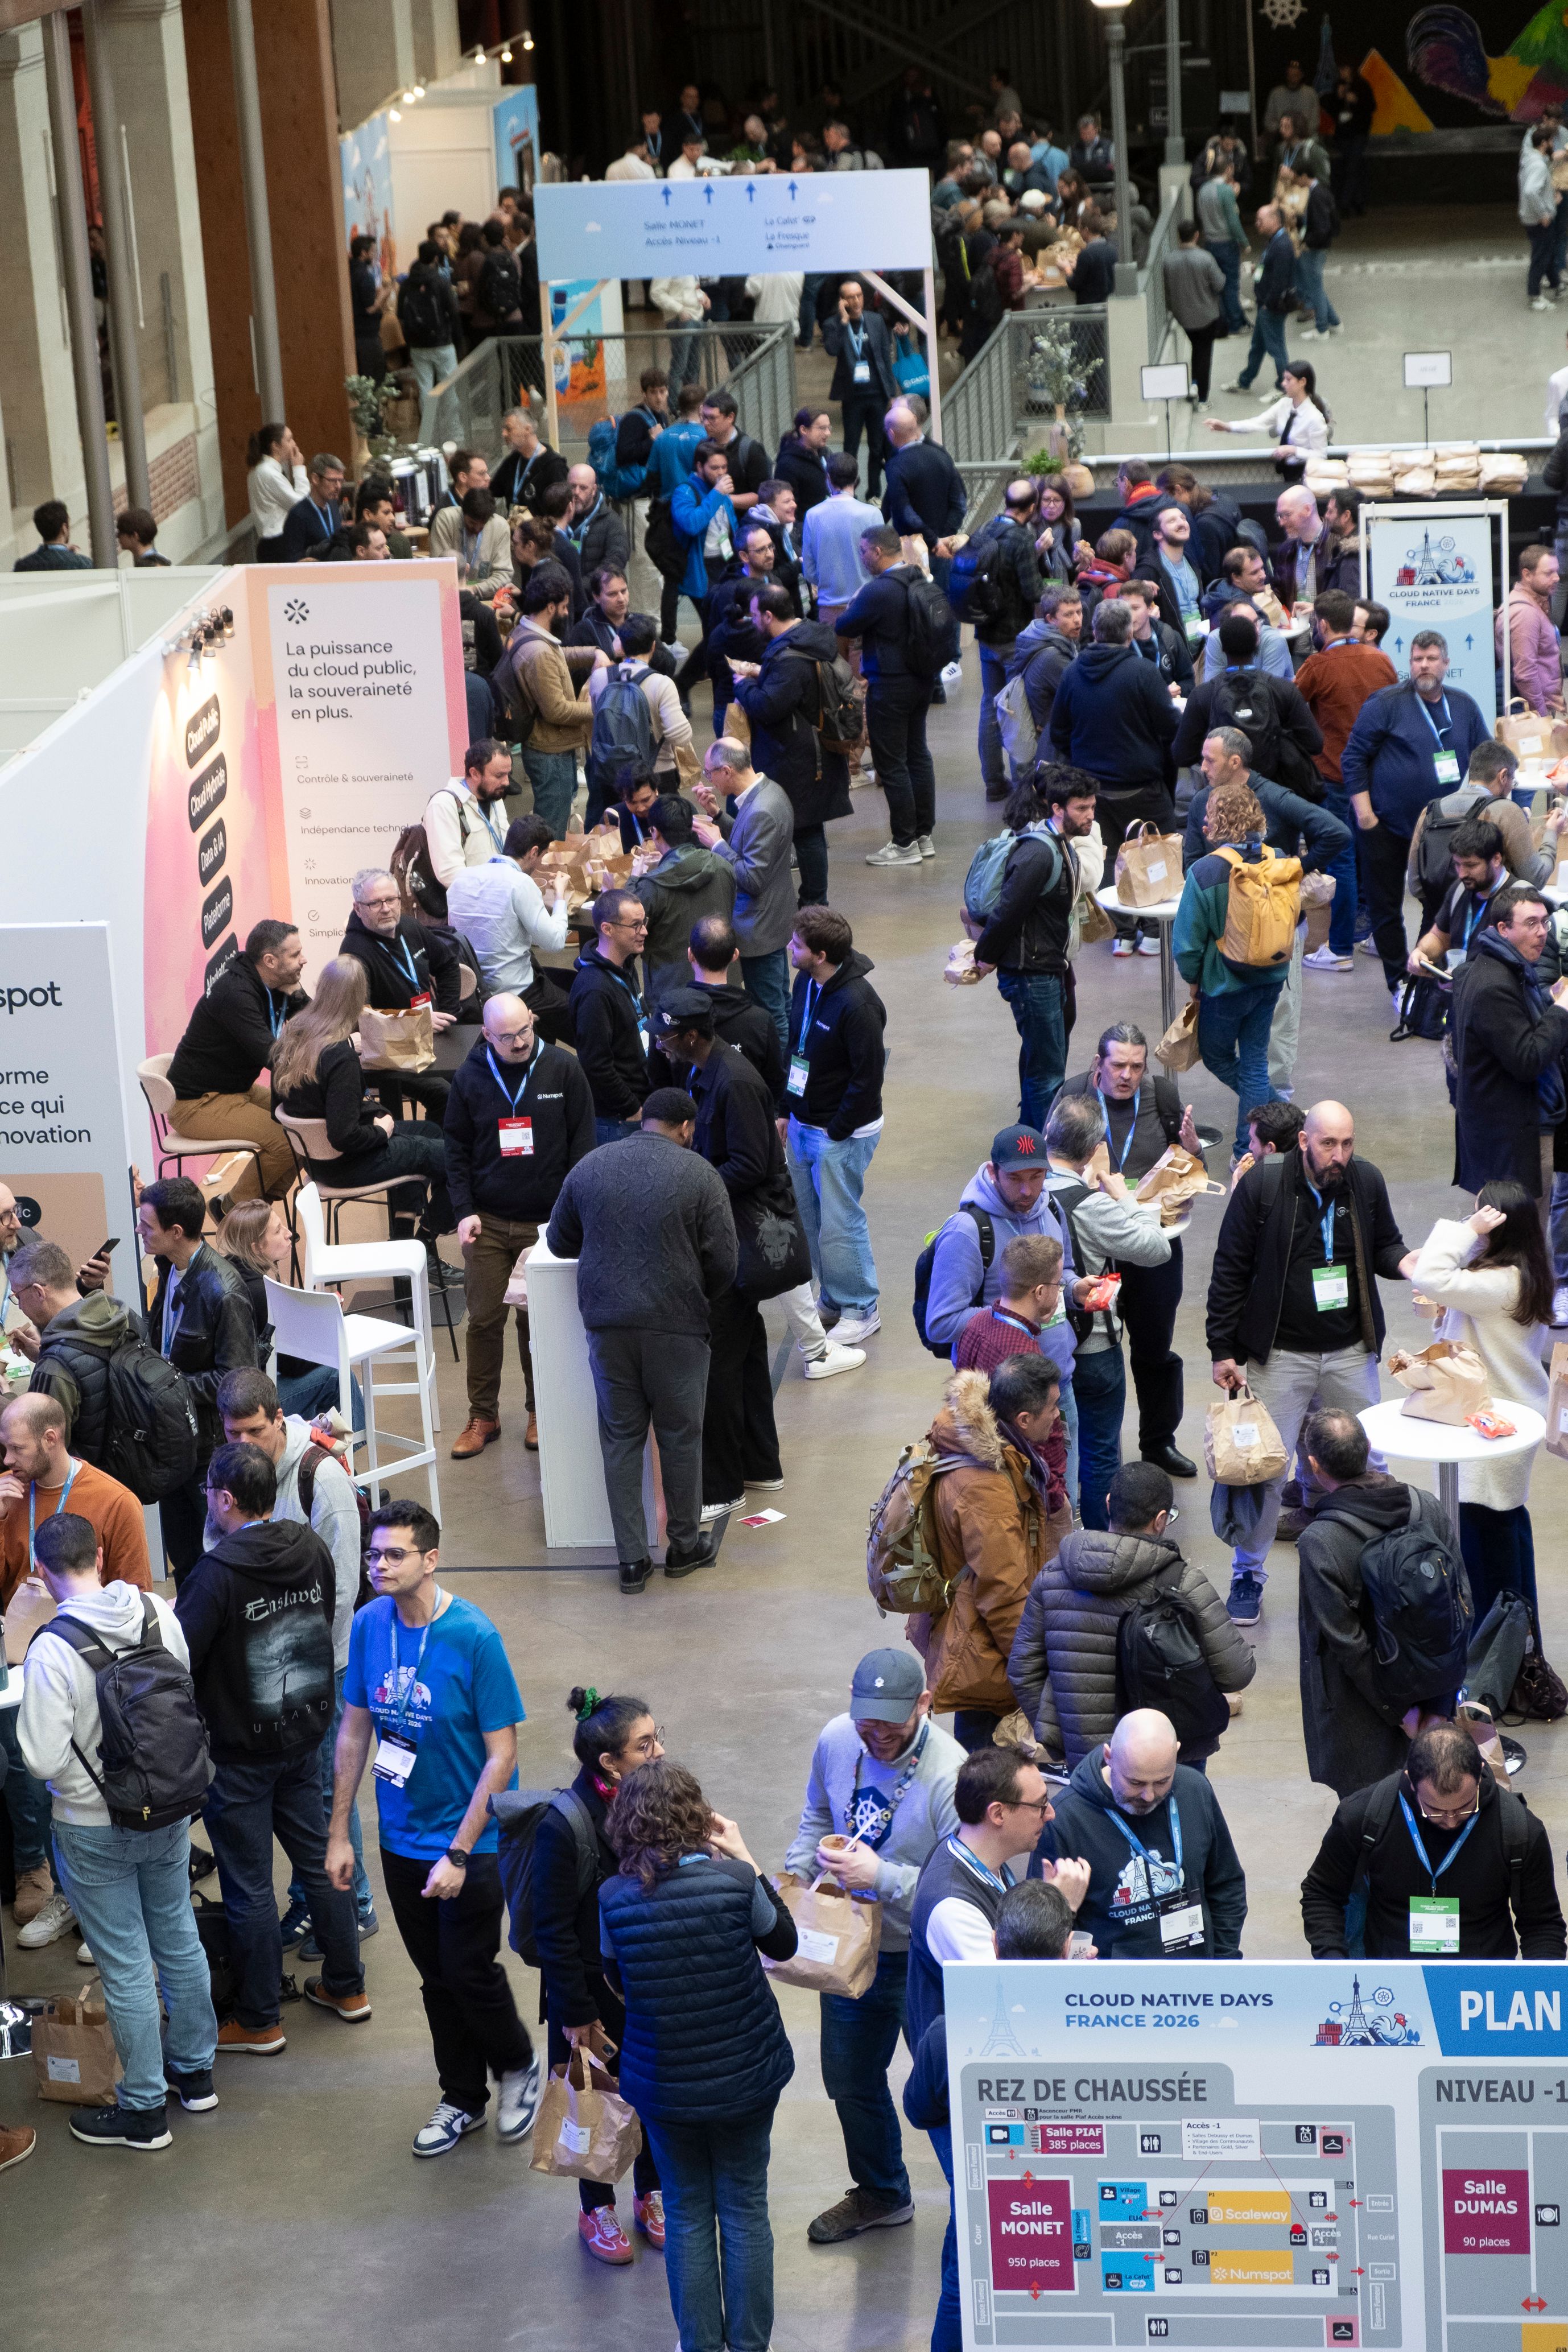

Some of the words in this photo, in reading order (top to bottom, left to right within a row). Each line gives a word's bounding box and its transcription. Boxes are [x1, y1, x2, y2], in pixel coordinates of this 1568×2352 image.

[644, 221, 666, 230] Salle
[670, 220, 704, 228] MONET
[645, 236, 672, 245] Accès
[676, 236, 707, 245] Niveau
[766, 232, 775, 241] La
[778, 232, 809, 242] Fresque
[286, 642, 305, 655] La
[310, 641, 393, 659] puissance
[288, 663, 308, 676] du
[313, 662, 358, 676] cloud
[363, 660, 416, 678] public,
[290, 685, 303, 698] la
[308, 681, 412, 698] souveraineté
[291, 708, 311, 719] en
[316, 705, 353, 722] plus.
[188, 721, 203, 753] Cloud
[203, 708, 218, 739] Public
[297, 774, 339, 783] Contrôle
[342, 774, 349, 782] &
[352, 772, 414, 782] souveraineté
[191, 785, 207, 817] Cloud
[205, 767, 225, 802] Hybride
[301, 825, 370, 836] Indépendance
[200, 845, 213, 872] Data
[213, 837, 218, 852] &
[218, 831, 225, 852] IA
[204, 893, 230, 934] Plateforme
[31, 1095, 64, 1119] qui
[240, 1579, 324, 1621] Enslaved
[254, 1701, 328, 1733] UTGARD
[1109, 1908, 1137, 1918] CLOUD
[1065, 1994, 1135, 2007] CLOUD
[1141, 1994, 1214, 2007] NATIVE
[1220, 1994, 1274, 2007] DAYS
[1460, 1991, 1561, 2031] PLAN
[1066, 2015, 1146, 2027] FRANCE
[1153, 2015, 1200, 2027] 2026
[978, 2079, 1025, 2102] REZ
[1034, 2079, 1067, 2102] DE
[1075, 2071, 1207, 2102] CHAUSSÉE
[1436, 2079, 1534, 2103] NIVEAU
[1544, 2079, 1568, 2103] -1
[1046, 2128, 1072, 2137] Salle
[1076, 2128, 1101, 2137] PIAF
[1049, 2140, 1067, 2149] 385
[1071, 2140, 1101, 2151] places
[1464, 2180, 1507, 2194] Salle
[1010, 2202, 1053, 2215] Salle
[1455, 2201, 1517, 2214] DUMAS
[1225, 2209, 1288, 2222] Scaleway
[1001, 2221, 1064, 2235] MONET
[1463, 2237, 1476, 2246] 90
[1479, 2237, 1510, 2248] places
[1008, 2258, 1026, 2267] 950
[1030, 2258, 1060, 2268] places
[1230, 2269, 1292, 2281] Numspot
